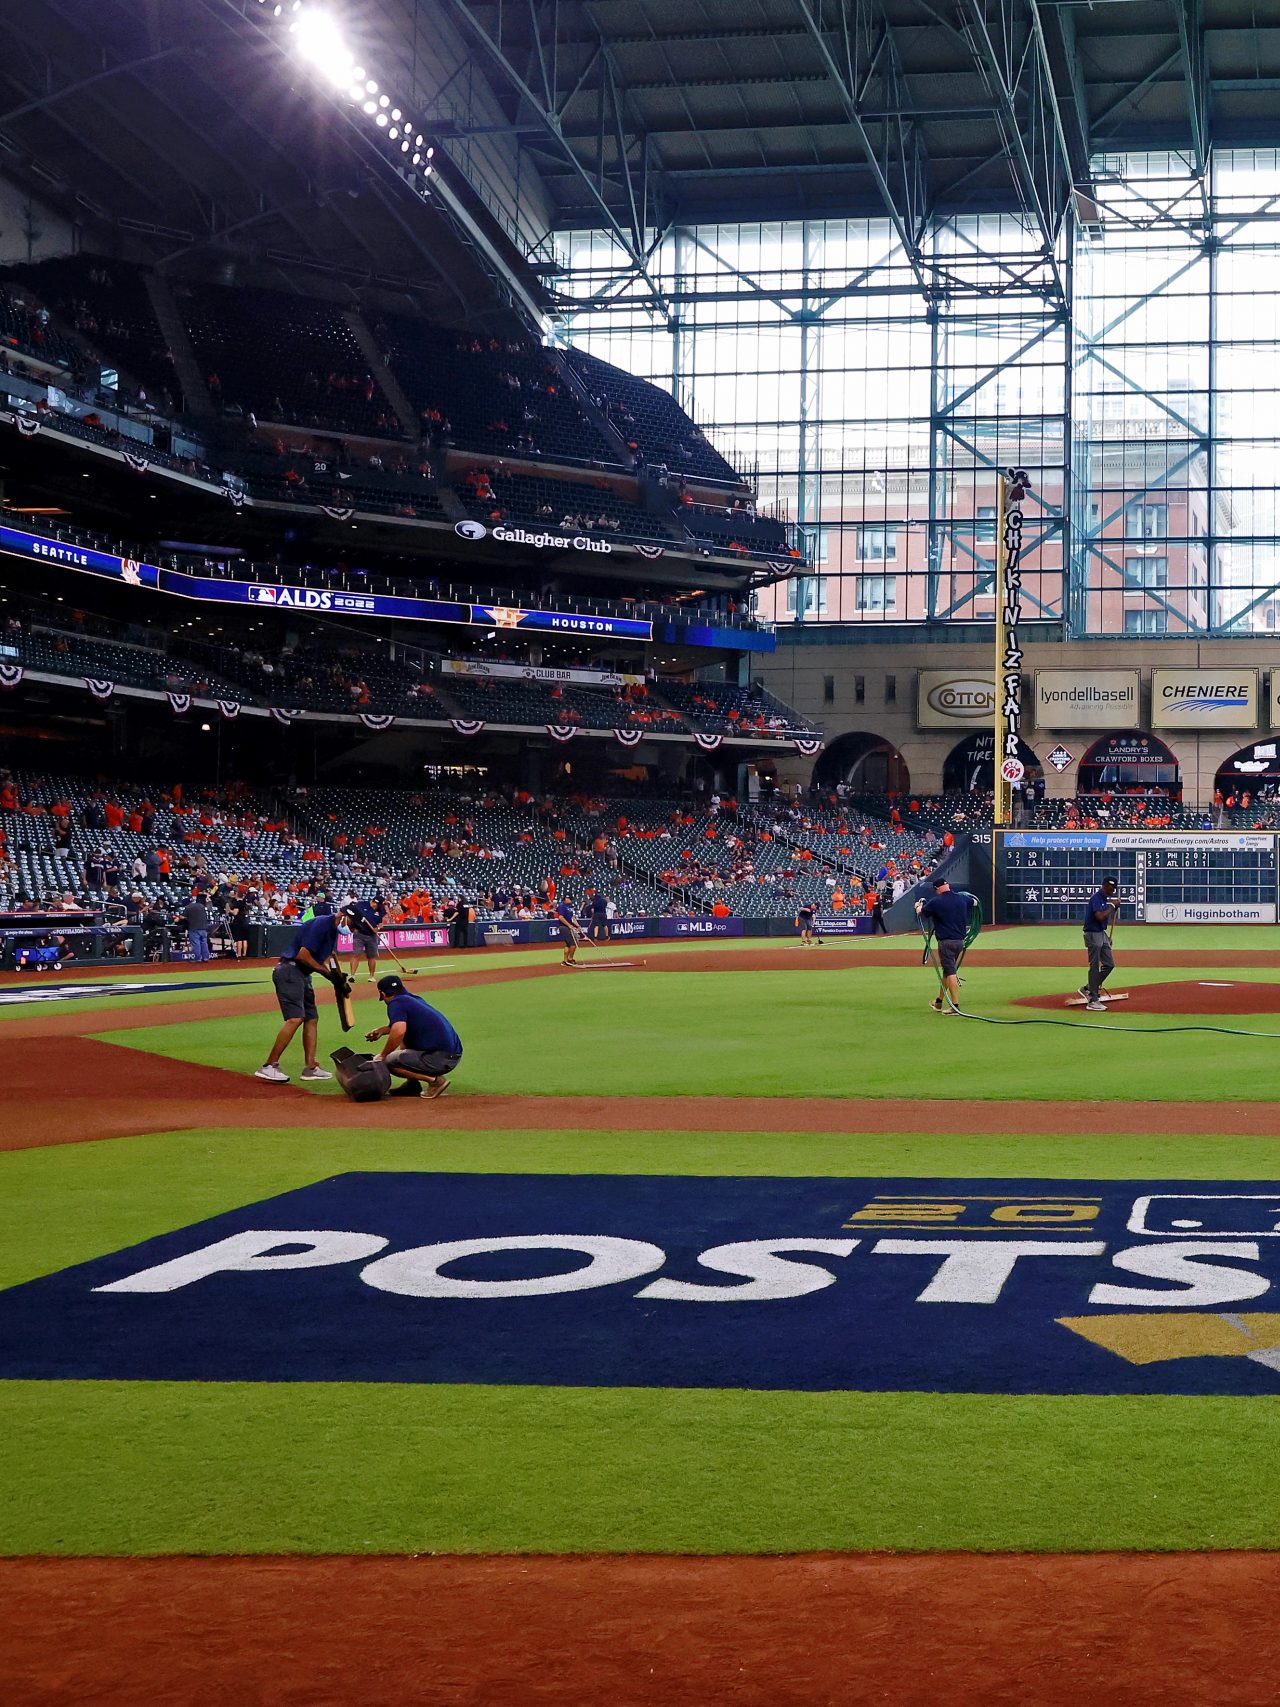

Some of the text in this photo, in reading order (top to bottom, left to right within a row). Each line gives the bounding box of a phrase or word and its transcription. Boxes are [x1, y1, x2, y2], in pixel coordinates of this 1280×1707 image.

[492, 527, 612, 553] Gallagher Club
[33, 543, 88, 566] SEATTLE
[276, 588, 375, 609] ALDS 2022
[551, 618, 613, 632] HOUSTON
[536, 669, 555, 679] CLUB
[556, 671, 571, 680] BAR
[1041, 687, 1134, 704] lyondellbasell
[1161, 685, 1249, 698] CHENIERE
[1004, 675, 1020, 755] FAIR
[971, 834, 992, 844] 315
[1031, 836, 1101, 846] Help protect your home
[1138, 836, 1229, 846] CenterPointEnergy.com/Astros
[1183, 908, 1260, 920] Higginbotham
[689, 921, 727, 932] MLB App
[405, 930, 426, 941] Mobile
